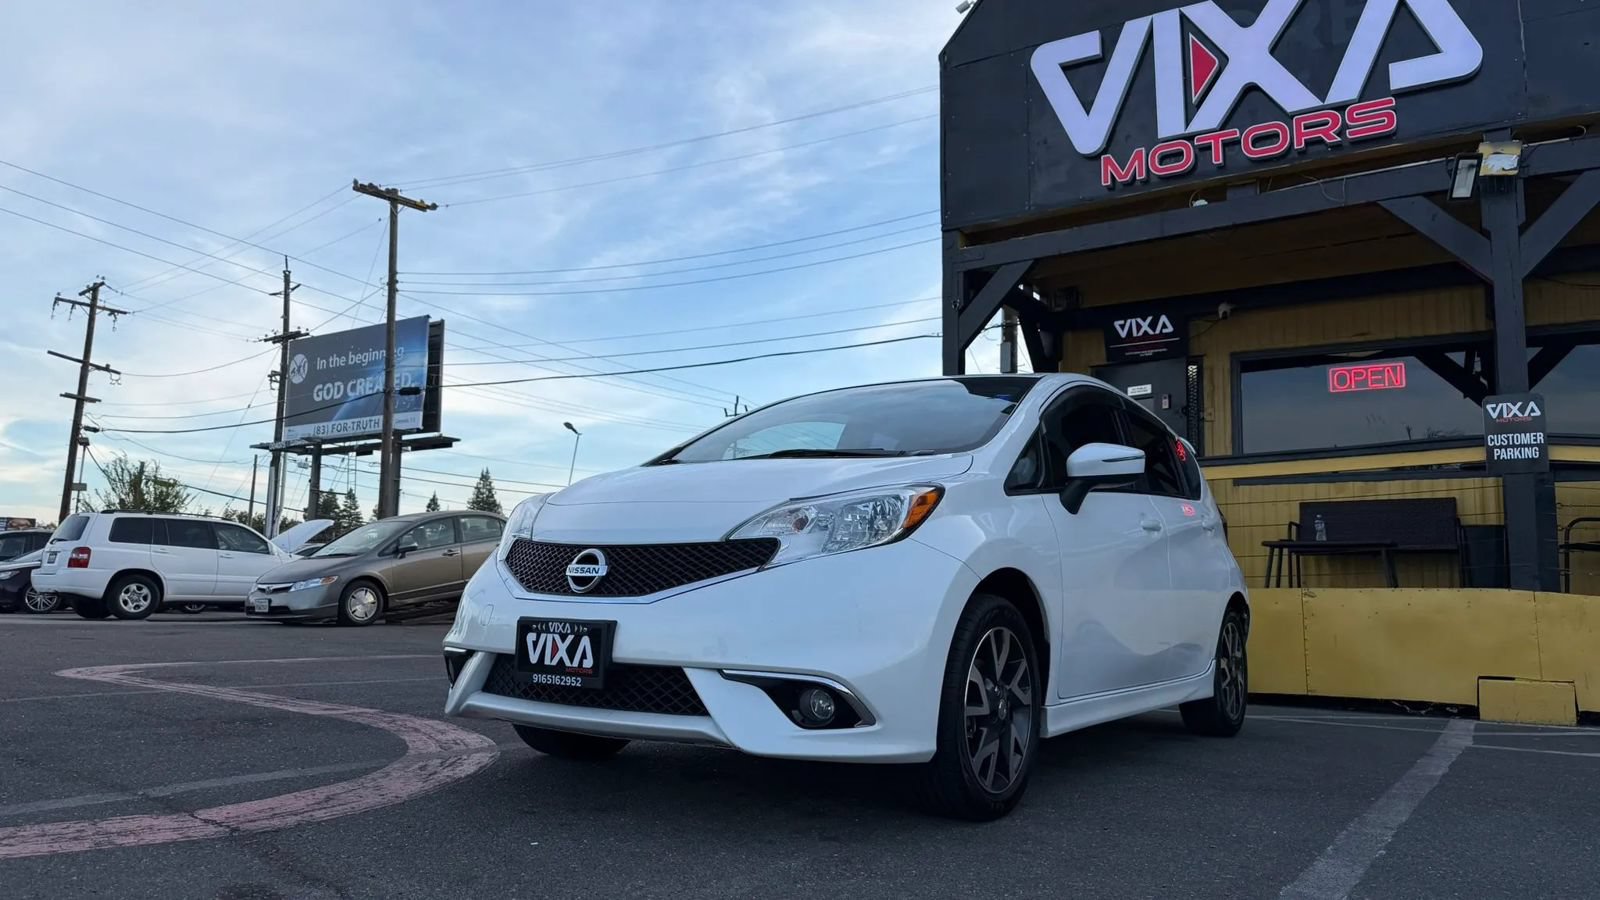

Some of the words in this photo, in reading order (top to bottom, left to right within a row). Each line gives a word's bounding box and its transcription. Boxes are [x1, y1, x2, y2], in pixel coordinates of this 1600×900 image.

[1031, 0, 1483, 156] VIXA
[1100, 97, 1397, 187] MOTORS
[1113, 314, 1175, 339] VIXA
[316, 357, 327, 370] In
[329, 354, 346, 367] the
[348, 347, 404, 366] beginng
[1333, 366, 1402, 390] OPEN
[313, 382, 344, 402] GOD
[1486, 401, 1541, 419] VIXA
[313, 422, 329, 437] (83)
[331, 418, 380, 433] FOR-TRUTH
[1487, 432, 1544, 446] CUSTOMER
[1493, 447, 1540, 460] PARKING
[568, 566, 600, 575] NISSAN
[548, 622, 571, 633] VIXA
[526, 632, 594, 668] VIXA
[532, 673, 582, 687] 9165162952
